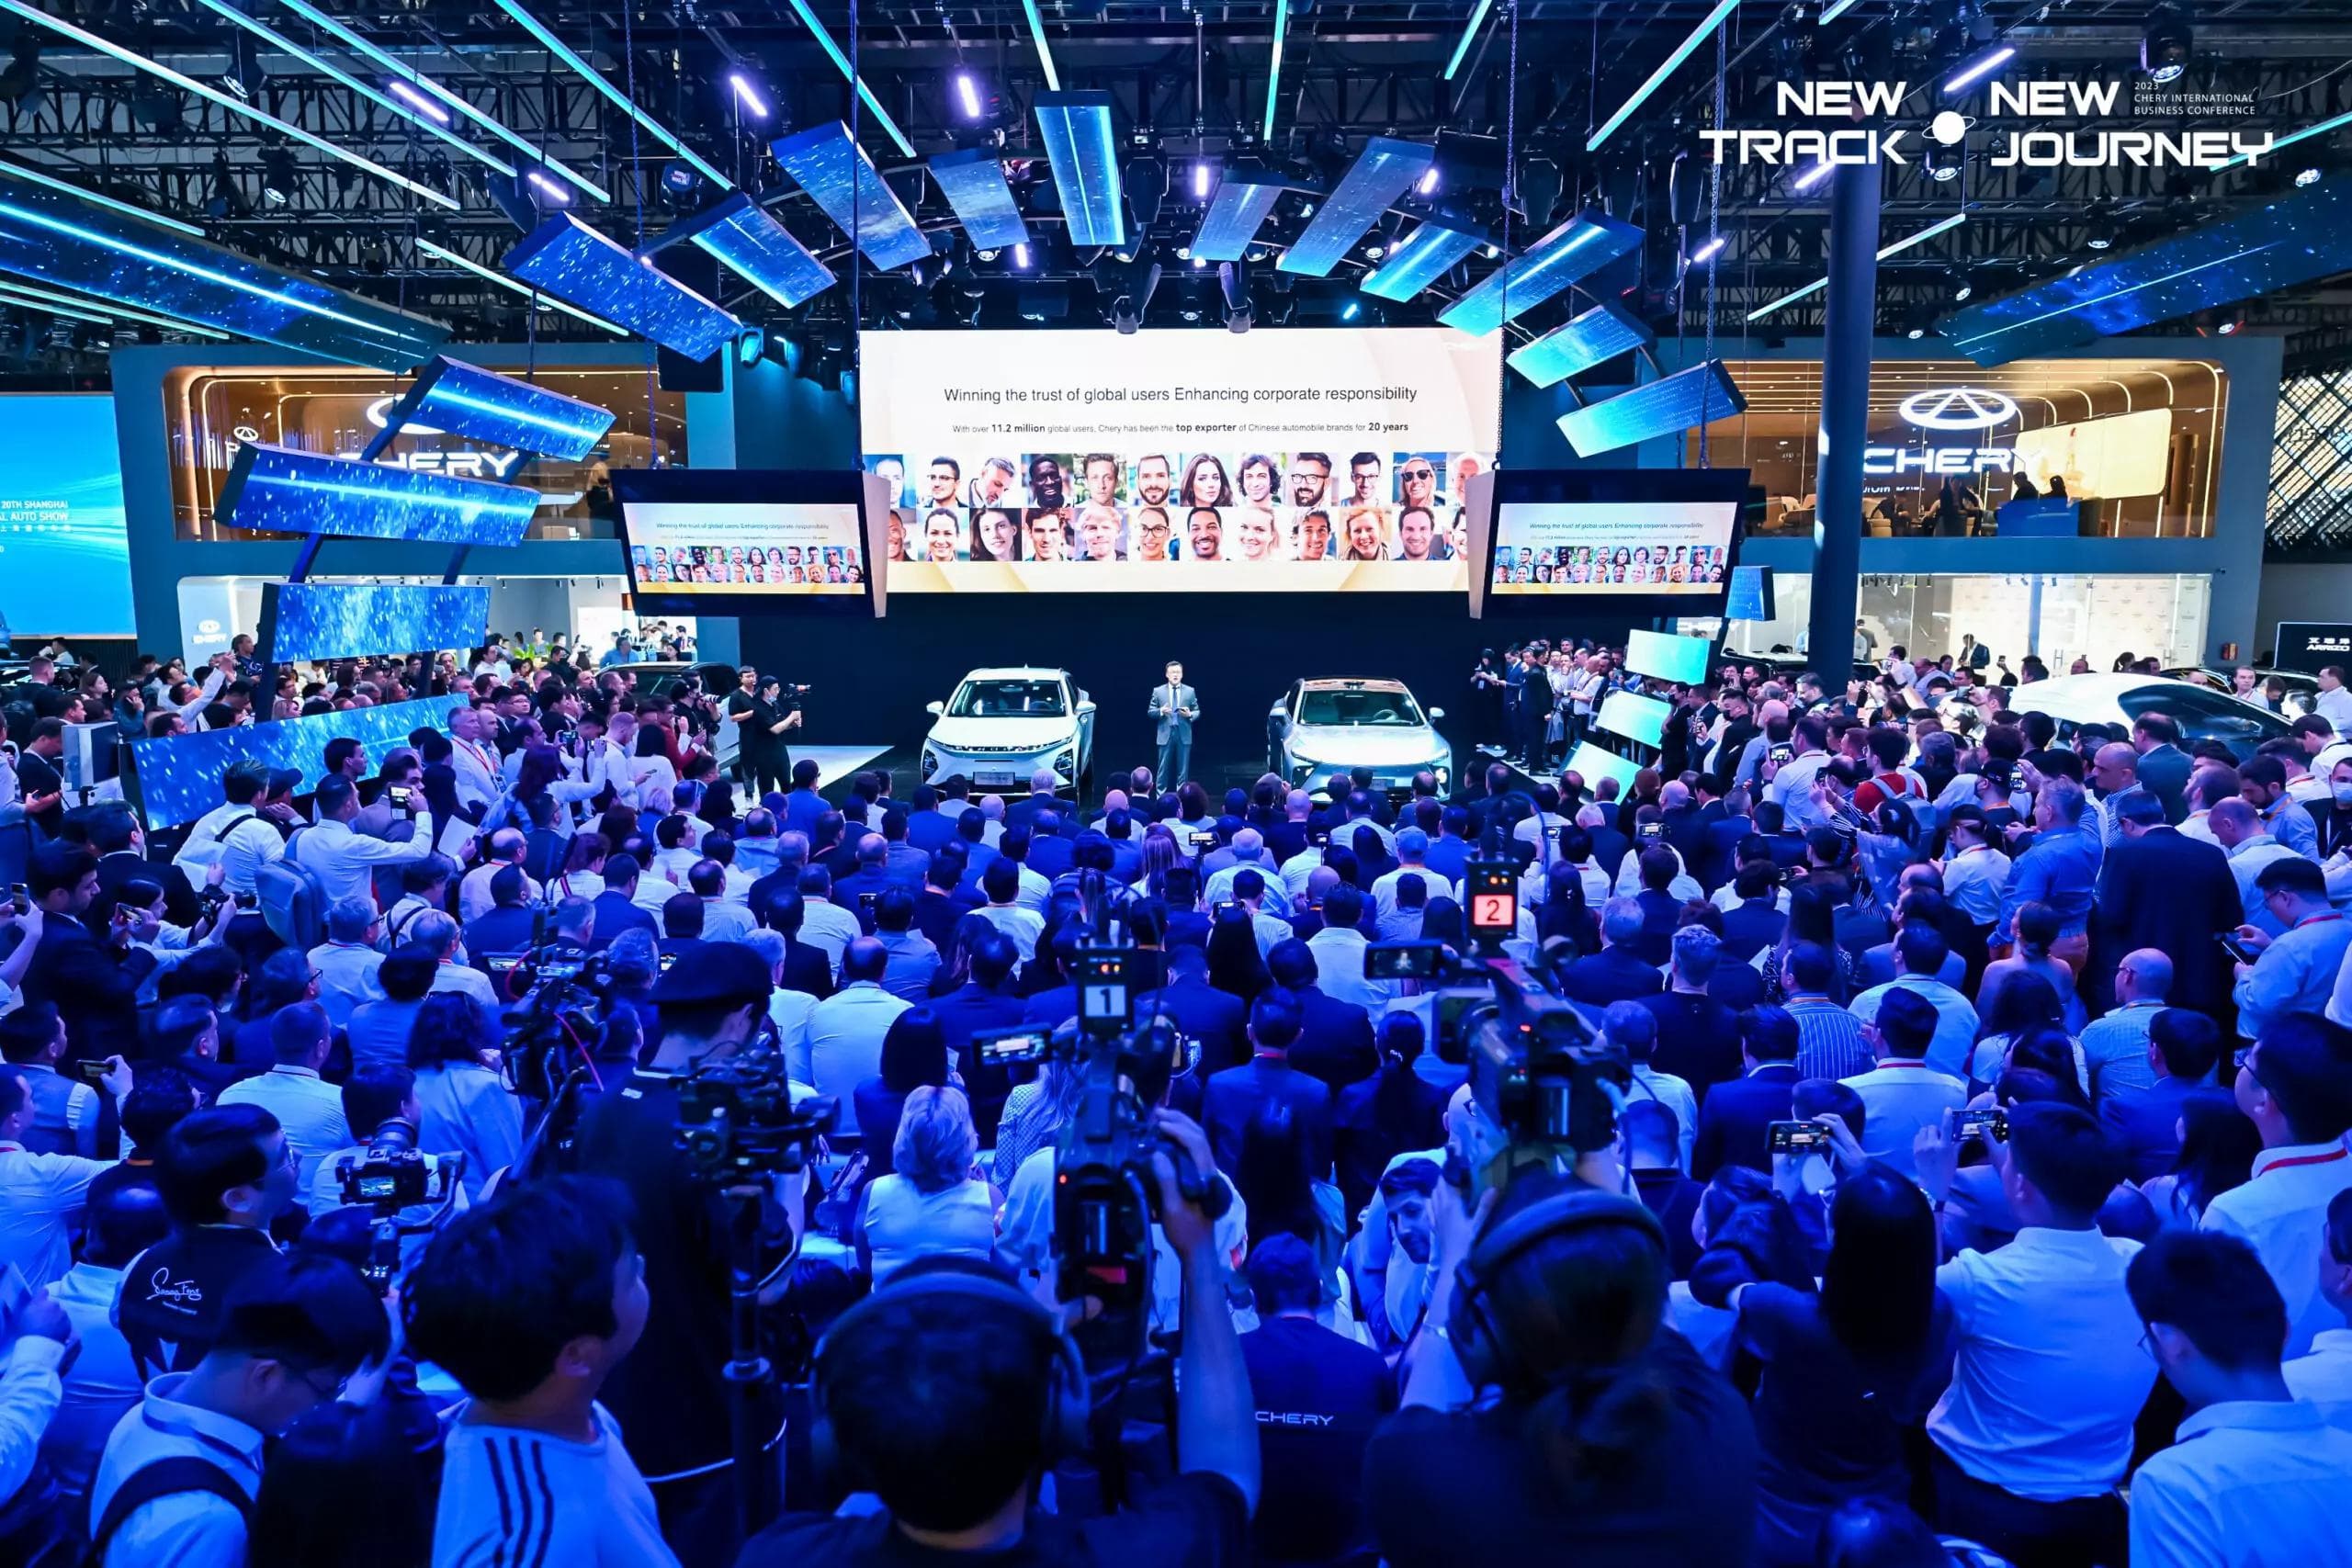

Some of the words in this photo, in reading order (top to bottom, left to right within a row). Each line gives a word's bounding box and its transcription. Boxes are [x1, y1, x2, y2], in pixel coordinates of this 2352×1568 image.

[944, 388, 1001, 404] Winning
[1005, 388, 1027, 401] the
[1032, 388, 1062, 401] trust
[1067, 388, 1080, 401] of
[1084, 387, 1126, 404] global
[1131, 389, 1170, 401] users
[1175, 387, 1249, 403] Enhancing
[1253, 389, 1320, 403] corporate
[1325, 386, 1418, 402] responsibility
[952, 424, 970, 434] With
[991, 424, 1012, 434] 11.2
[1014, 423, 1046, 434] million
[1047, 424, 1070, 435] global
[1098, 424, 1122, 434] Chery
[1124, 424, 1138, 434] has
[1139, 424, 1159, 434] been
[1161, 423, 1174, 433] the
[1176, 423, 1193, 434] top
[1195, 423, 1237, 434] exporter
[1238, 423, 1247, 432] of
[1249, 423, 1280, 433] Chinese
[1283, 423, 1325, 433] automobile
[1327, 423, 1353, 433] brands
[1355, 423, 1366, 432] for
[1368, 422, 1380, 432] 20
[1383, 423, 1409, 434] years
[338, 451, 519, 477] ERY
[2, 501, 23, 509] 20TH
[24, 501, 69, 509] SHANGHAI
[10, 512, 37, 521] AUTO
[40, 512, 69, 521] SHOW
[1487, 899, 1500, 921] 2
[1100, 987, 1112, 1015] 1
[1255, 1411, 1334, 1426] CHERY
